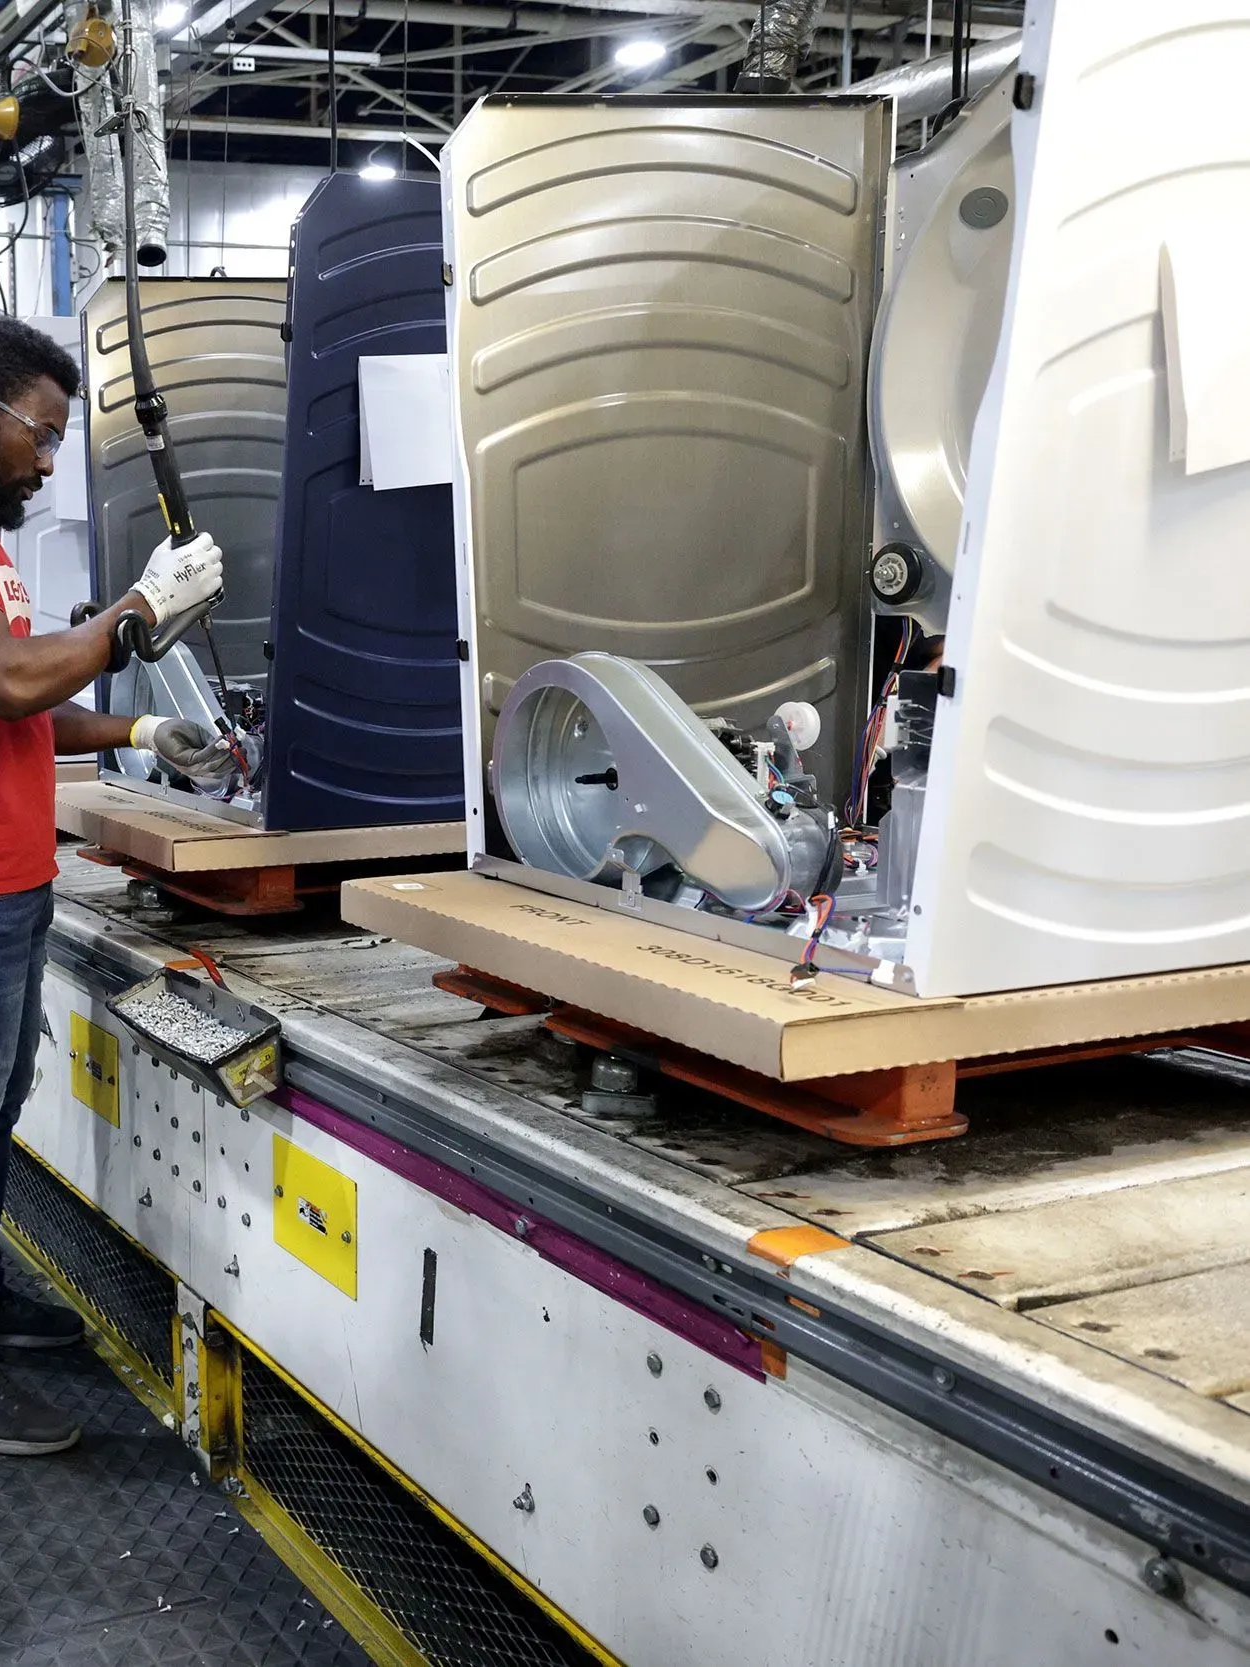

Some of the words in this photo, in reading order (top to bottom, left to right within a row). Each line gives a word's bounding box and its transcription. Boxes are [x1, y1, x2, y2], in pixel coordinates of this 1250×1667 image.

[173, 563, 206, 583] HyFlex
[508, 903, 591, 926] FRONT
[636, 944, 854, 1007] 308D1618G001
